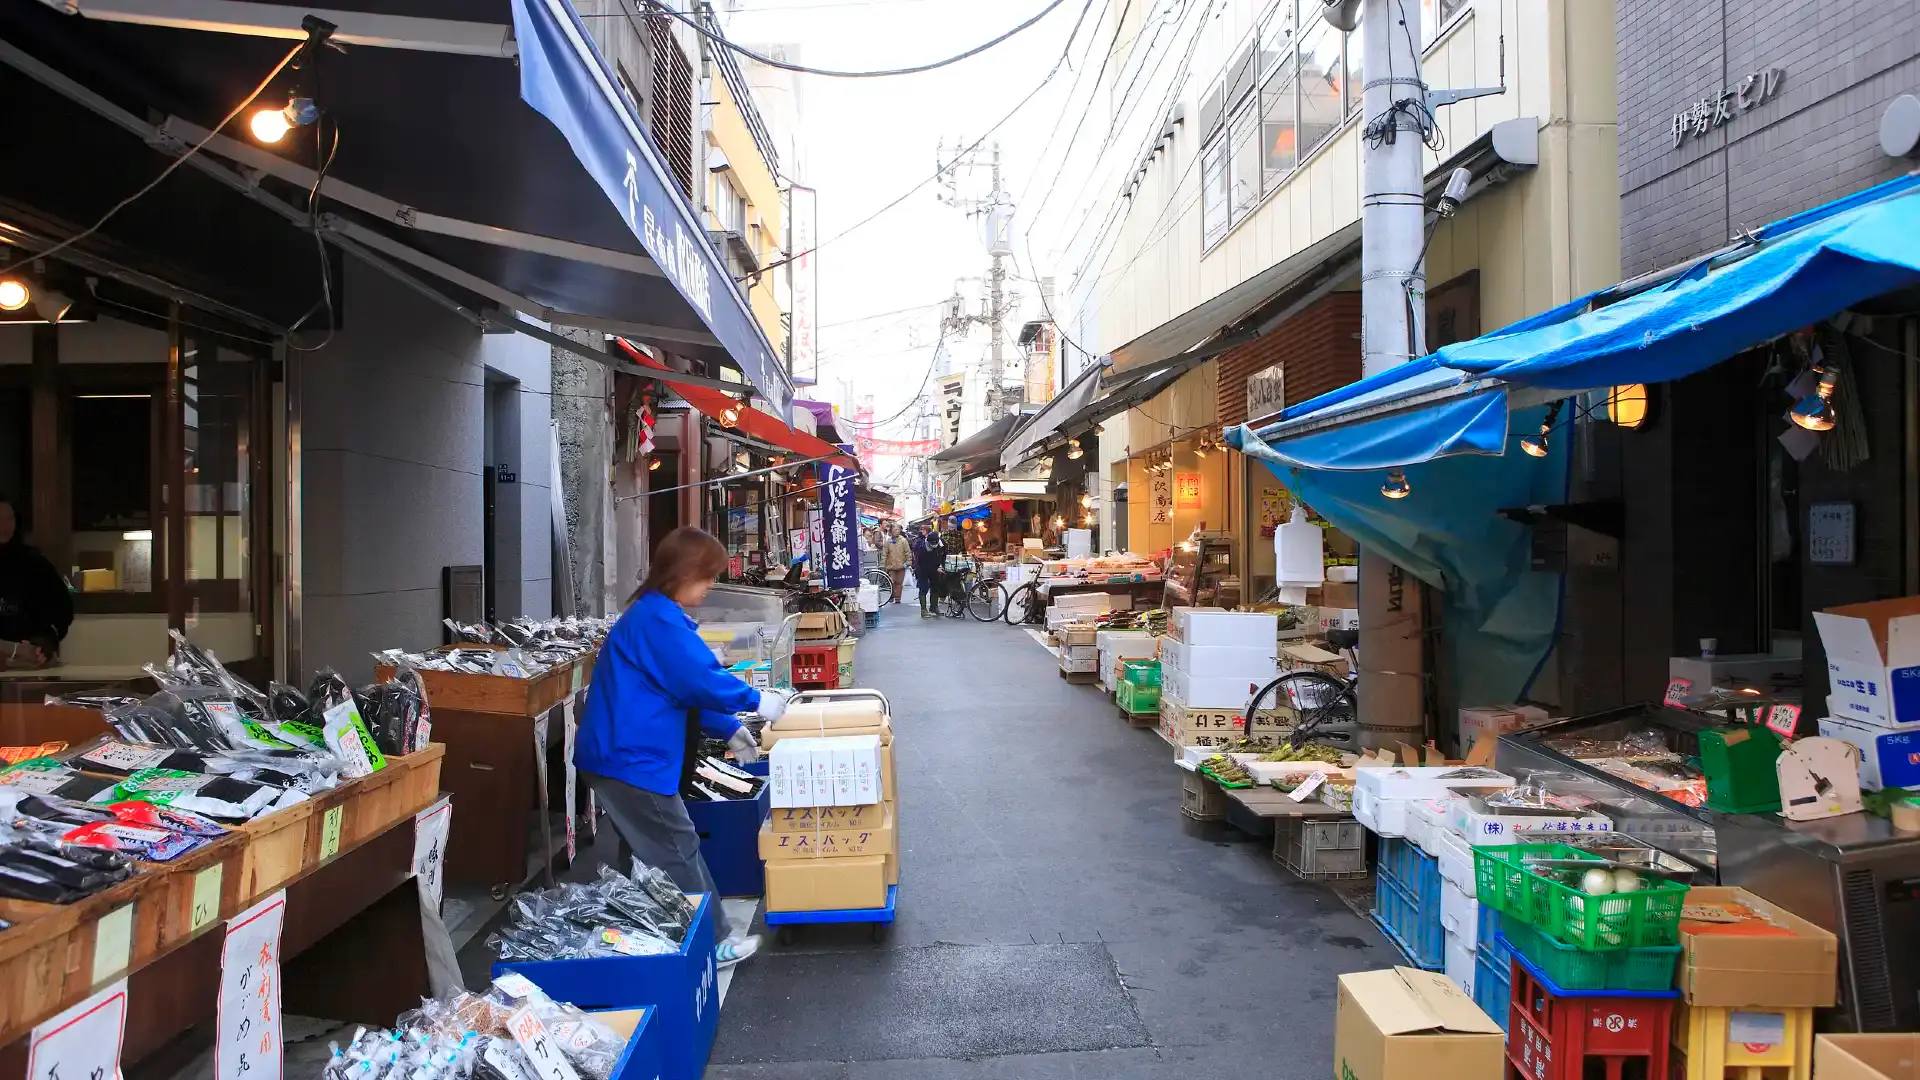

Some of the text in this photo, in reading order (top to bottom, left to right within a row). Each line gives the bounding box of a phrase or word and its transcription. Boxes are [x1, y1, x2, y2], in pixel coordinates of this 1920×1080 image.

[1670, 67, 1786, 149] 伊勢友ビル
[1483, 821, 1504, 835] (株)
